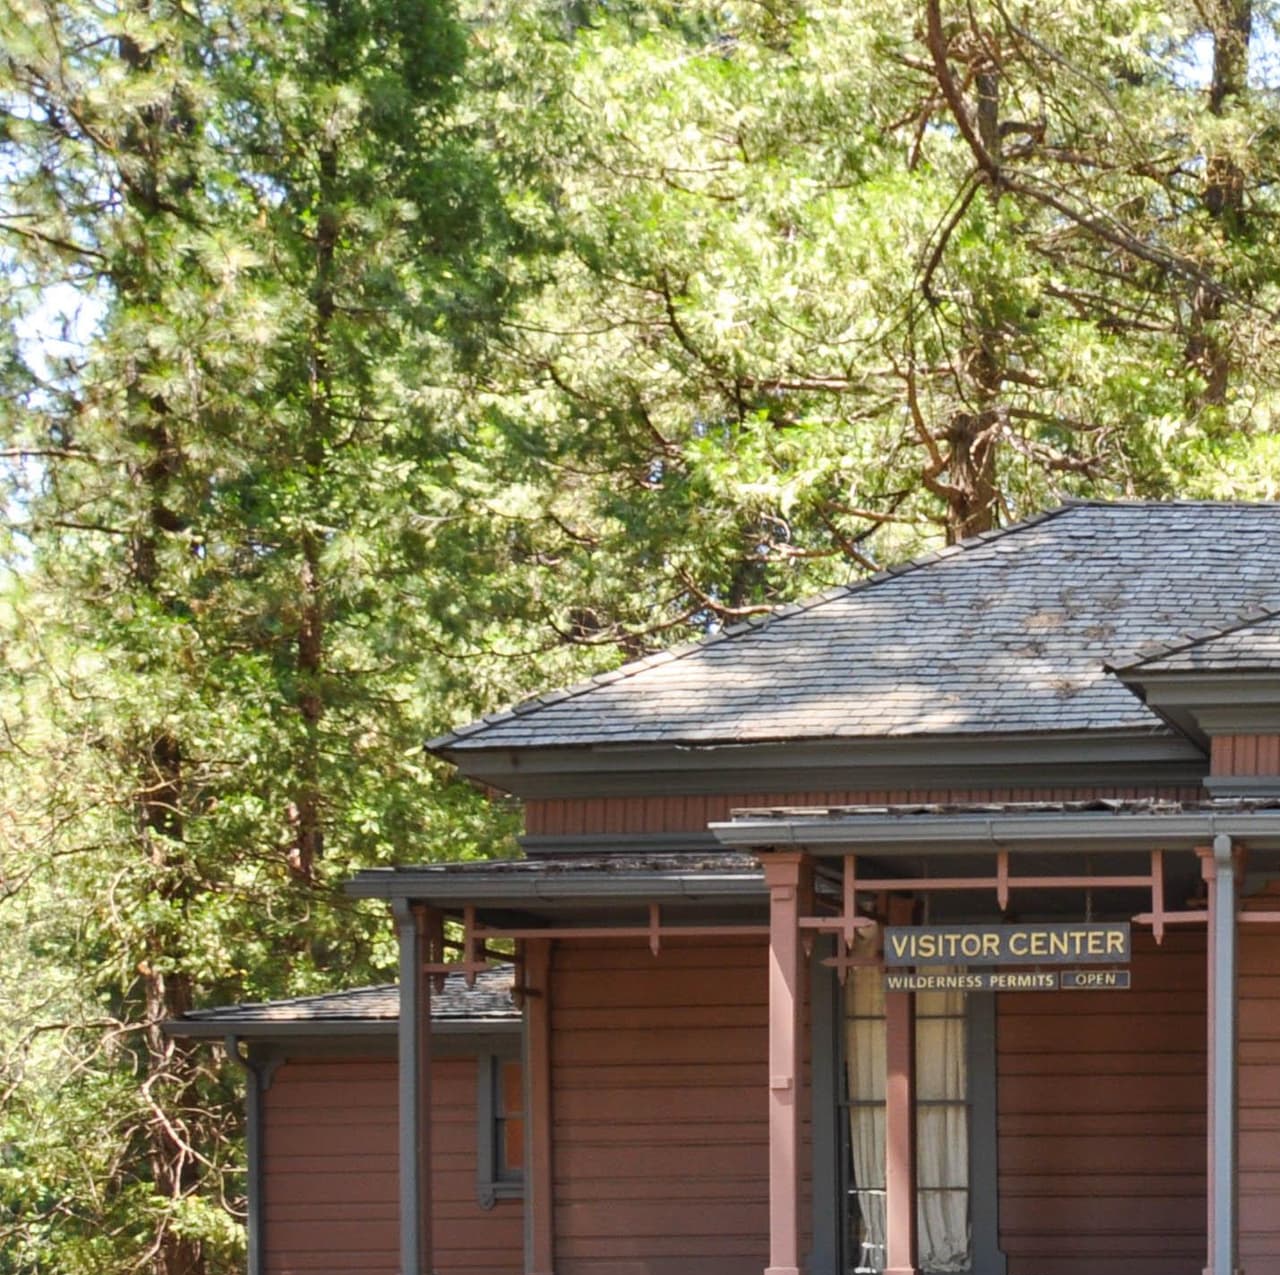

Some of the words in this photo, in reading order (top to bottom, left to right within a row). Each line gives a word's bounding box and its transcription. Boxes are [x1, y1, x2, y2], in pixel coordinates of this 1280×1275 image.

[891, 933, 1001, 958] VISITOR
[1008, 931, 1125, 956] CENTER
[888, 974, 983, 989] WILDERNESS
[989, 973, 1054, 988] PERMITS
[1075, 973, 1116, 986] OPEN
